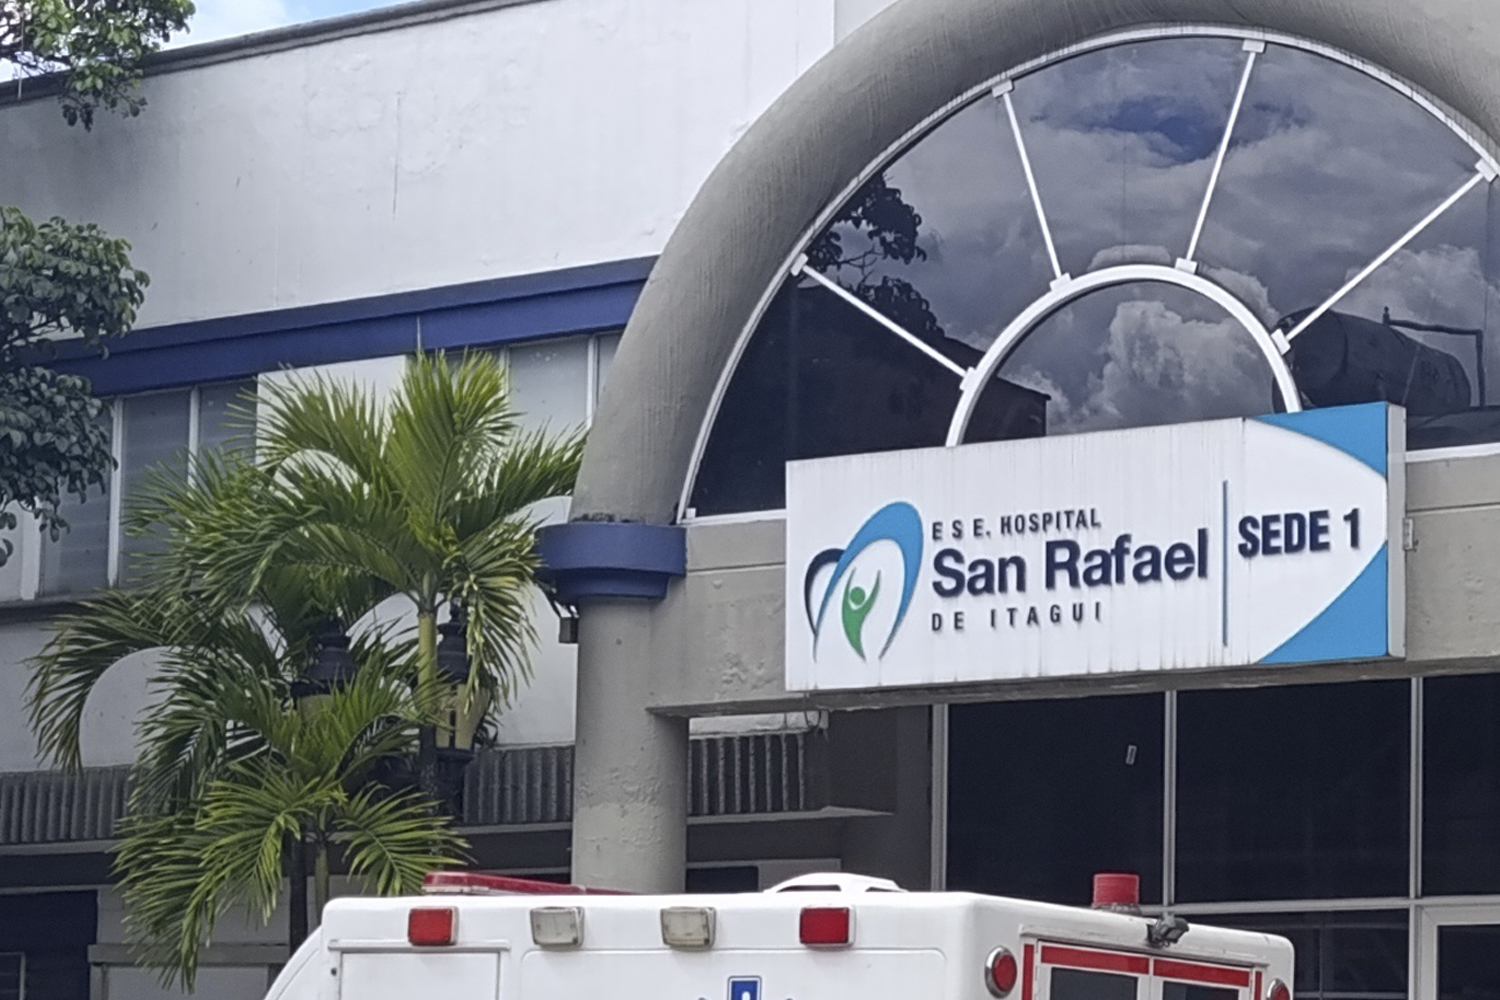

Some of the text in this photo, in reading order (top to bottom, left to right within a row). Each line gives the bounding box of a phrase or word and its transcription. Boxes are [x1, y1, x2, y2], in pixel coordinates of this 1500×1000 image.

[1000, 508, 1102, 535] HOSPITAL
[1238, 508, 1360, 558] SEDE 1
[932, 527, 1208, 599] San Rafael
[931, 601, 1101, 632] DE ITAGUI
